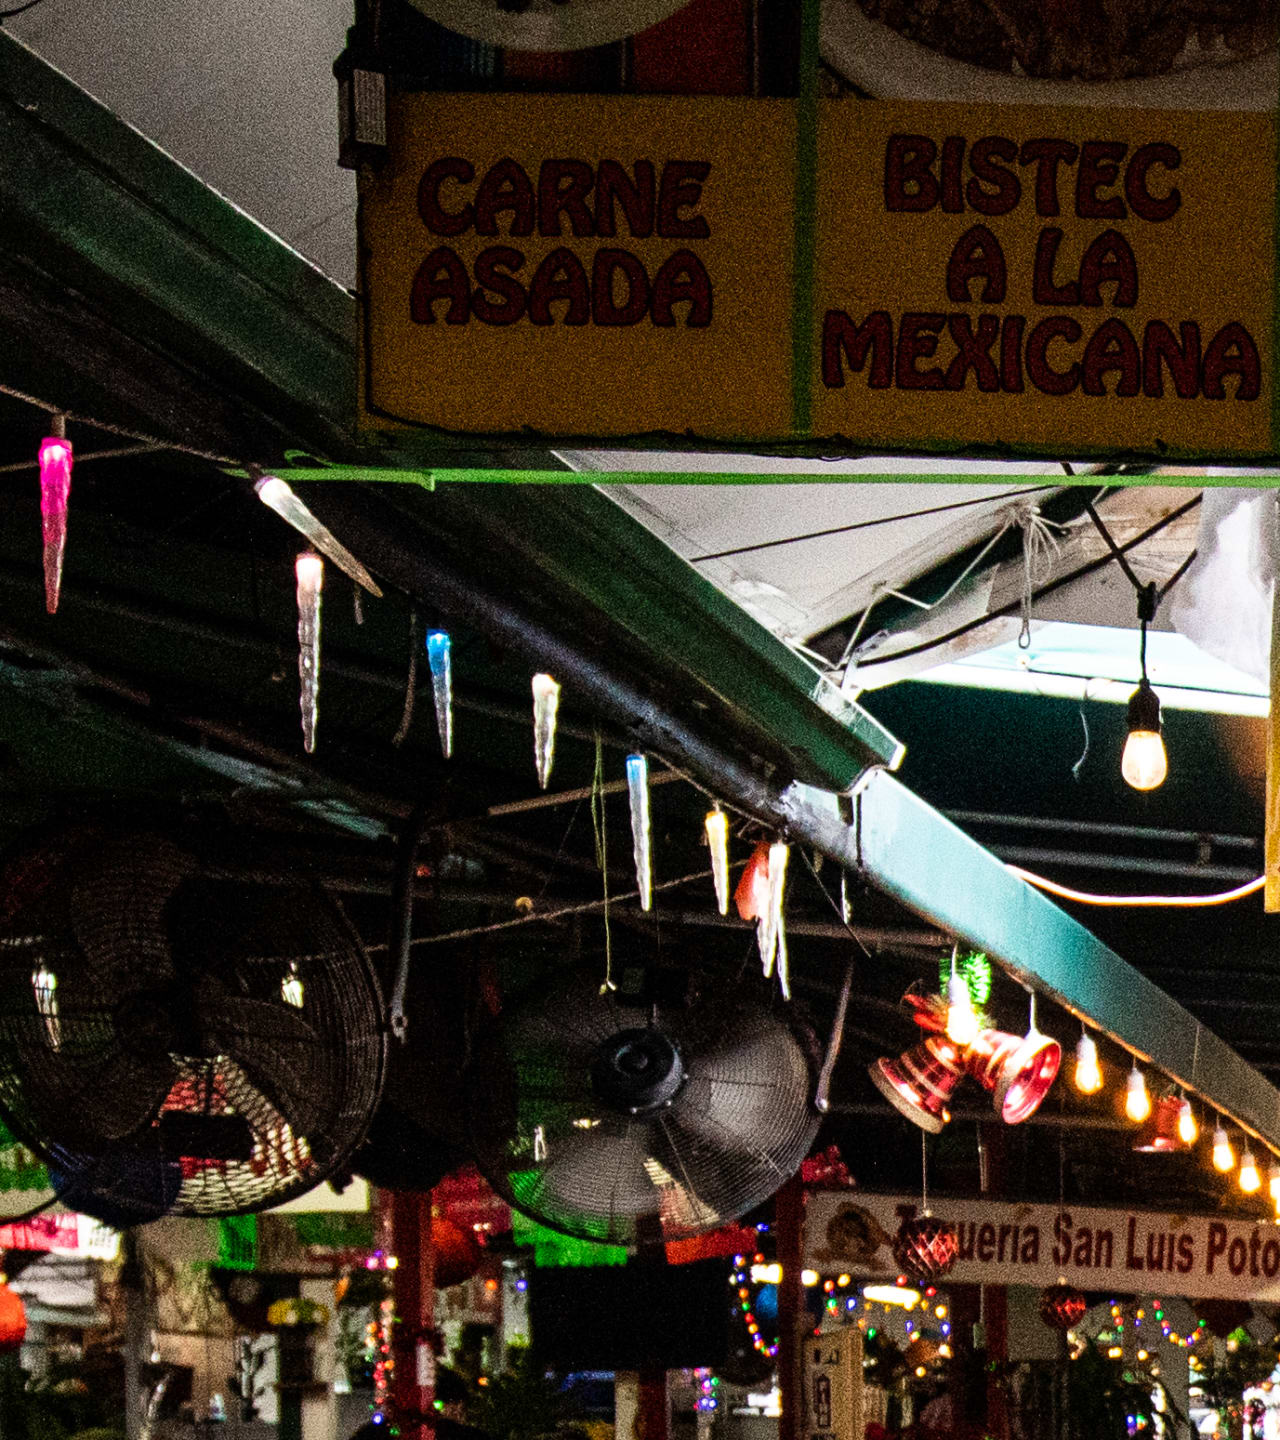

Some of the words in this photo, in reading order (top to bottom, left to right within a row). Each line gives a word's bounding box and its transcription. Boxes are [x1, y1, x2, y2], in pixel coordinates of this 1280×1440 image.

[416, 158, 712, 239] CARNE
[885, 134, 1182, 222] BISTEC
[410, 247, 713, 327] ASADA
[947, 225, 1007, 304] A
[1033, 228, 1138, 307] LA
[822, 310, 1260, 400] MEXICANA
[896, 1203, 1040, 1264] ueria
[1052, 1213, 1113, 1269] San
[1126, 1217, 1194, 1274] Luis
